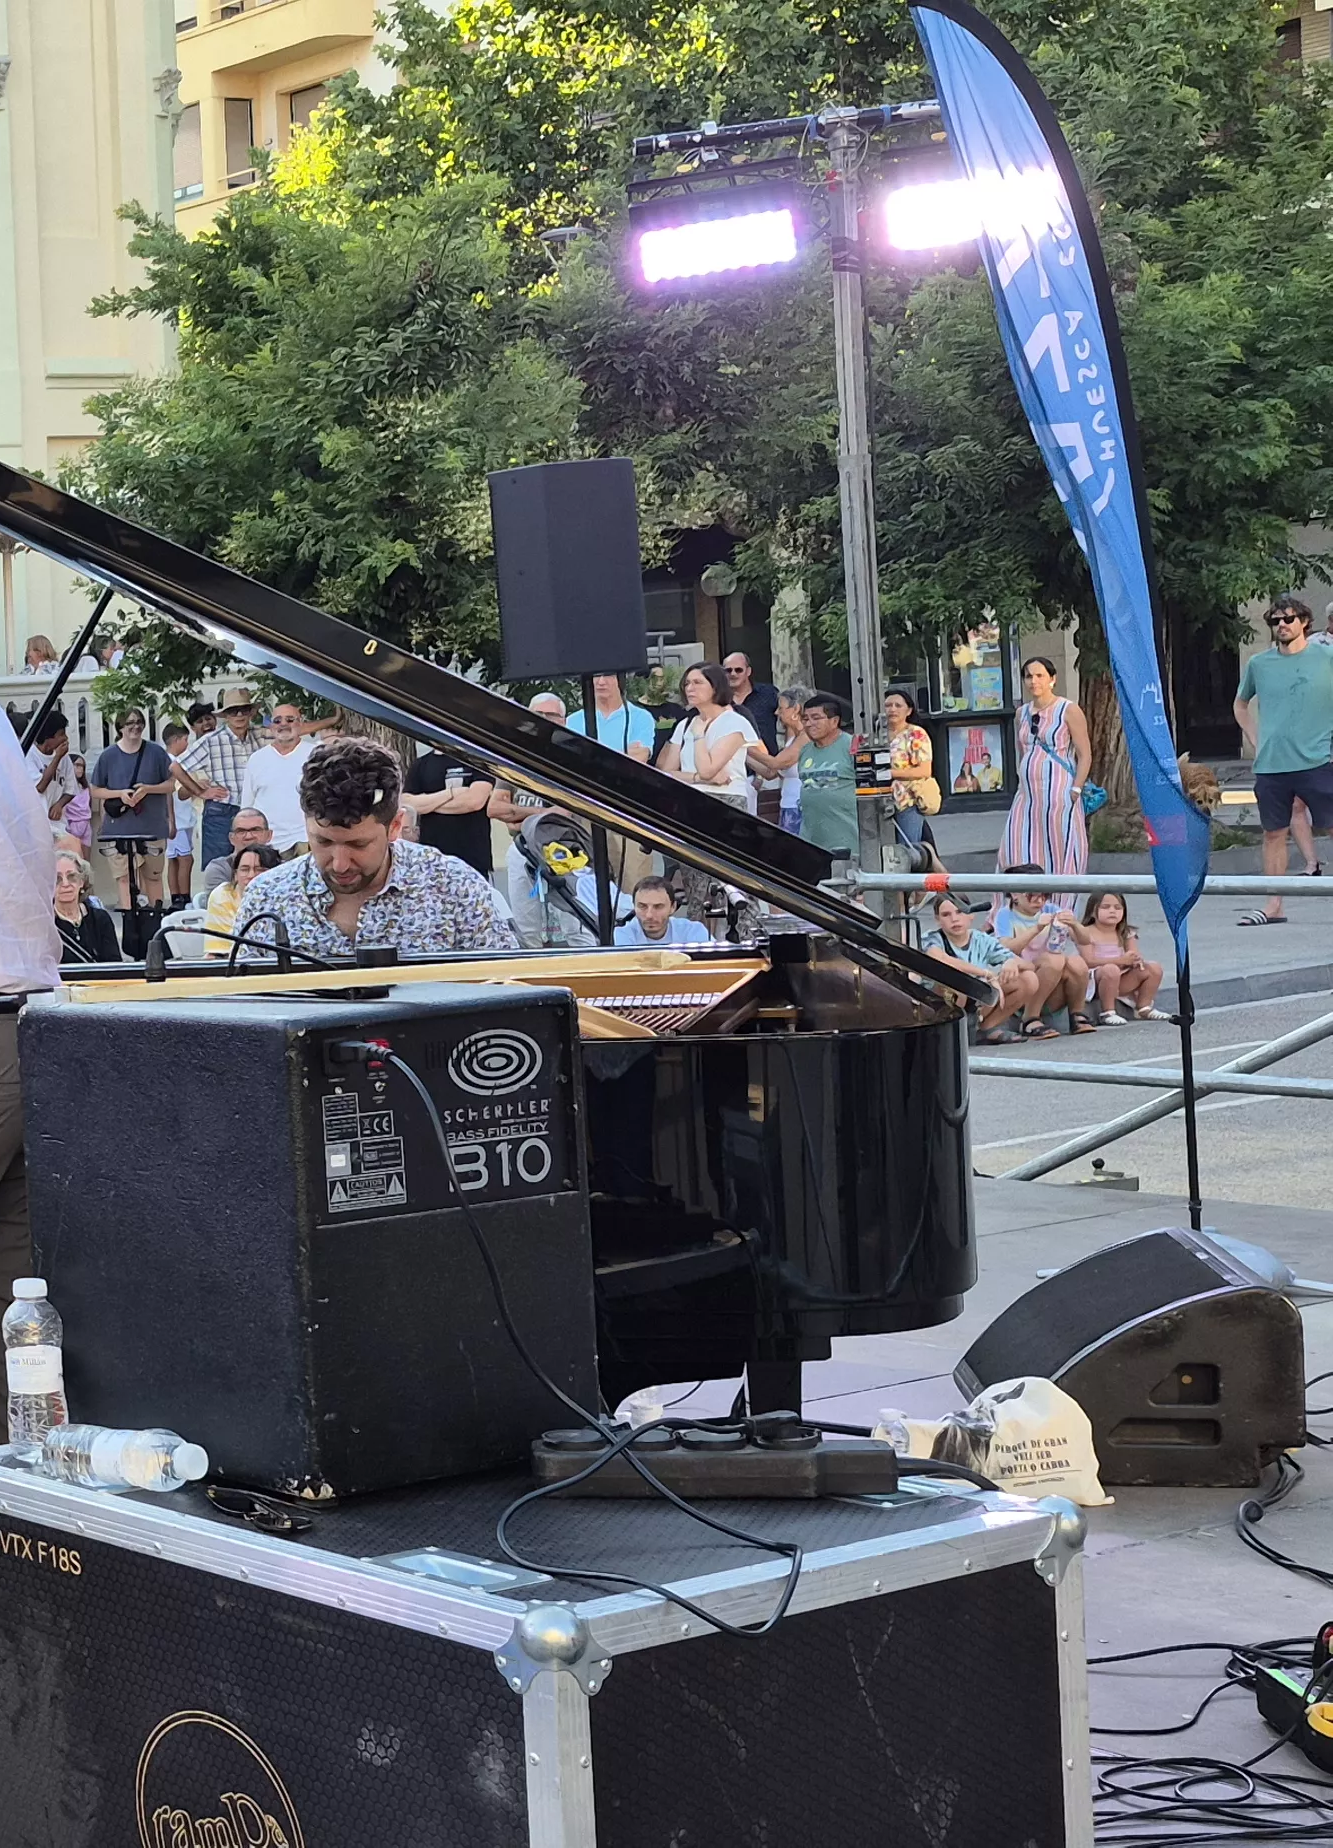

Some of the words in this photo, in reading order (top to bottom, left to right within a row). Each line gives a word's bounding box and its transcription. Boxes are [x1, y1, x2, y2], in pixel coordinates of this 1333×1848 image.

[446, 1130, 485, 1143] BASS
[487, 1121, 549, 1138] FIDELITY
[448, 1137, 552, 1193] B10
[37, 1540, 82, 1575] F18S
